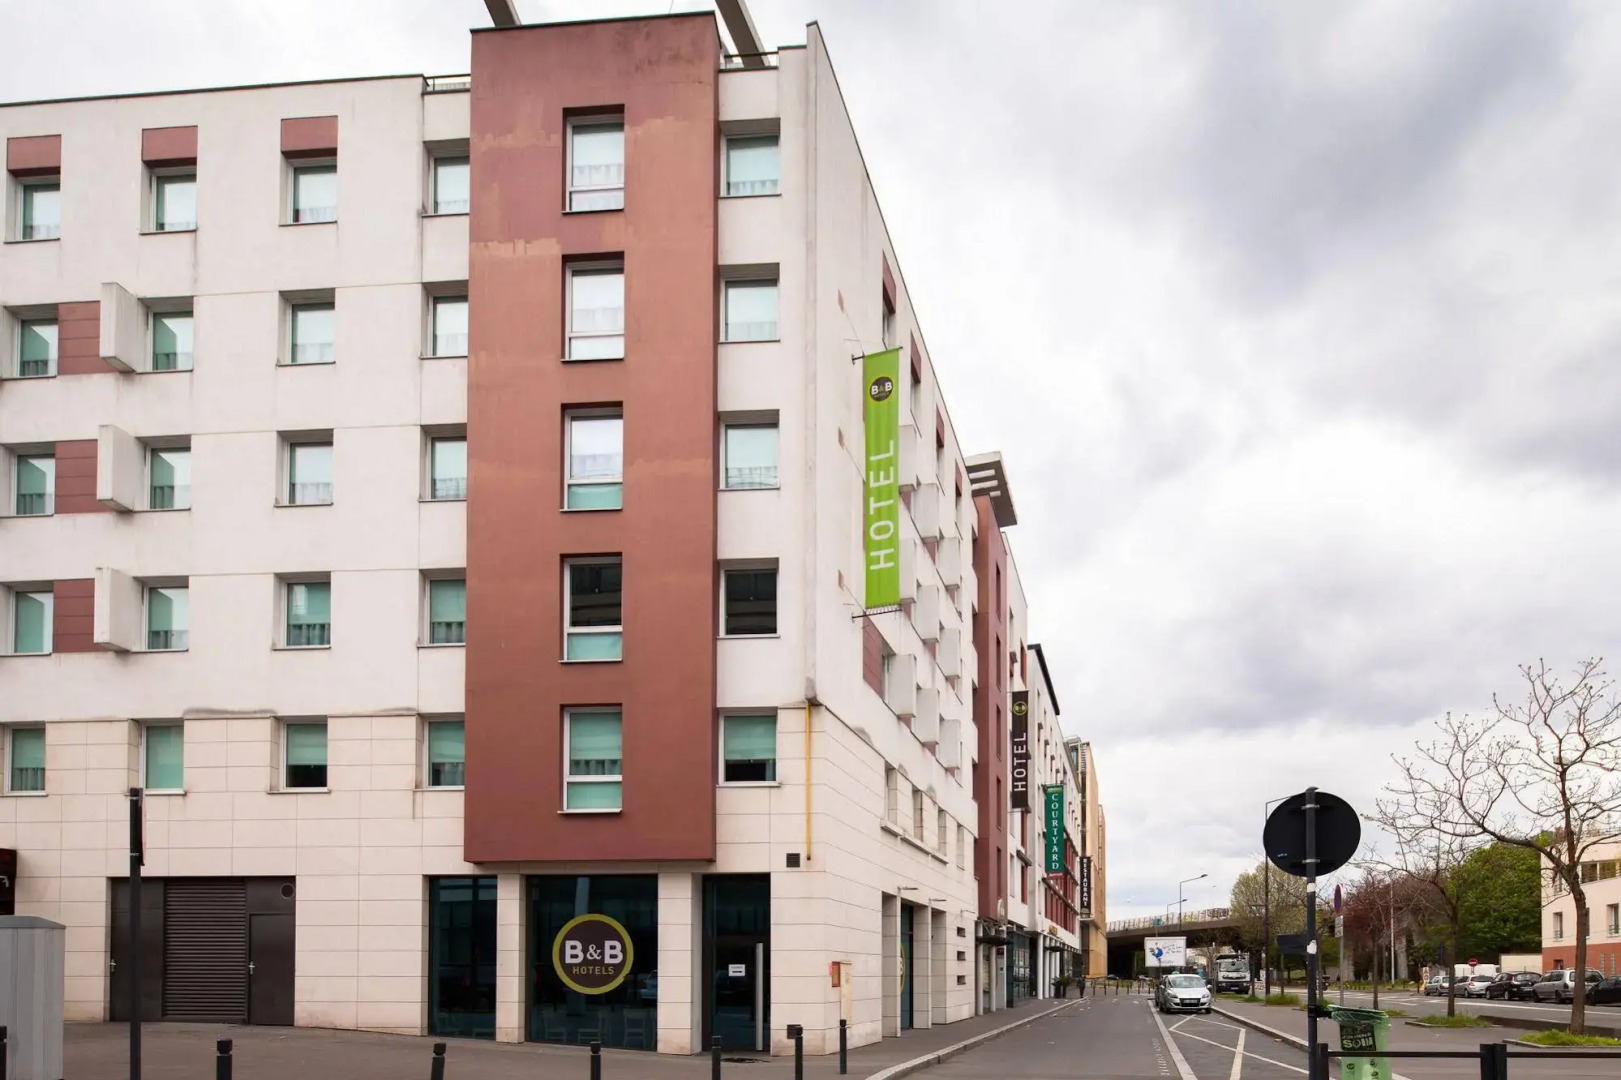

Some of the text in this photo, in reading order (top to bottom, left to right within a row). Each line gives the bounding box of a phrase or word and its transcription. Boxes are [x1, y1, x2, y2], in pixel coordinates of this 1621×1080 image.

[871, 381, 892, 395] B&B
[869, 440, 894, 570] HOTEL
[1014, 732, 1027, 791] HOTEL
[1051, 793, 1059, 870] COURTYARD
[565, 940, 623, 964] B&B
[572, 966, 615, 975] HOTELS
